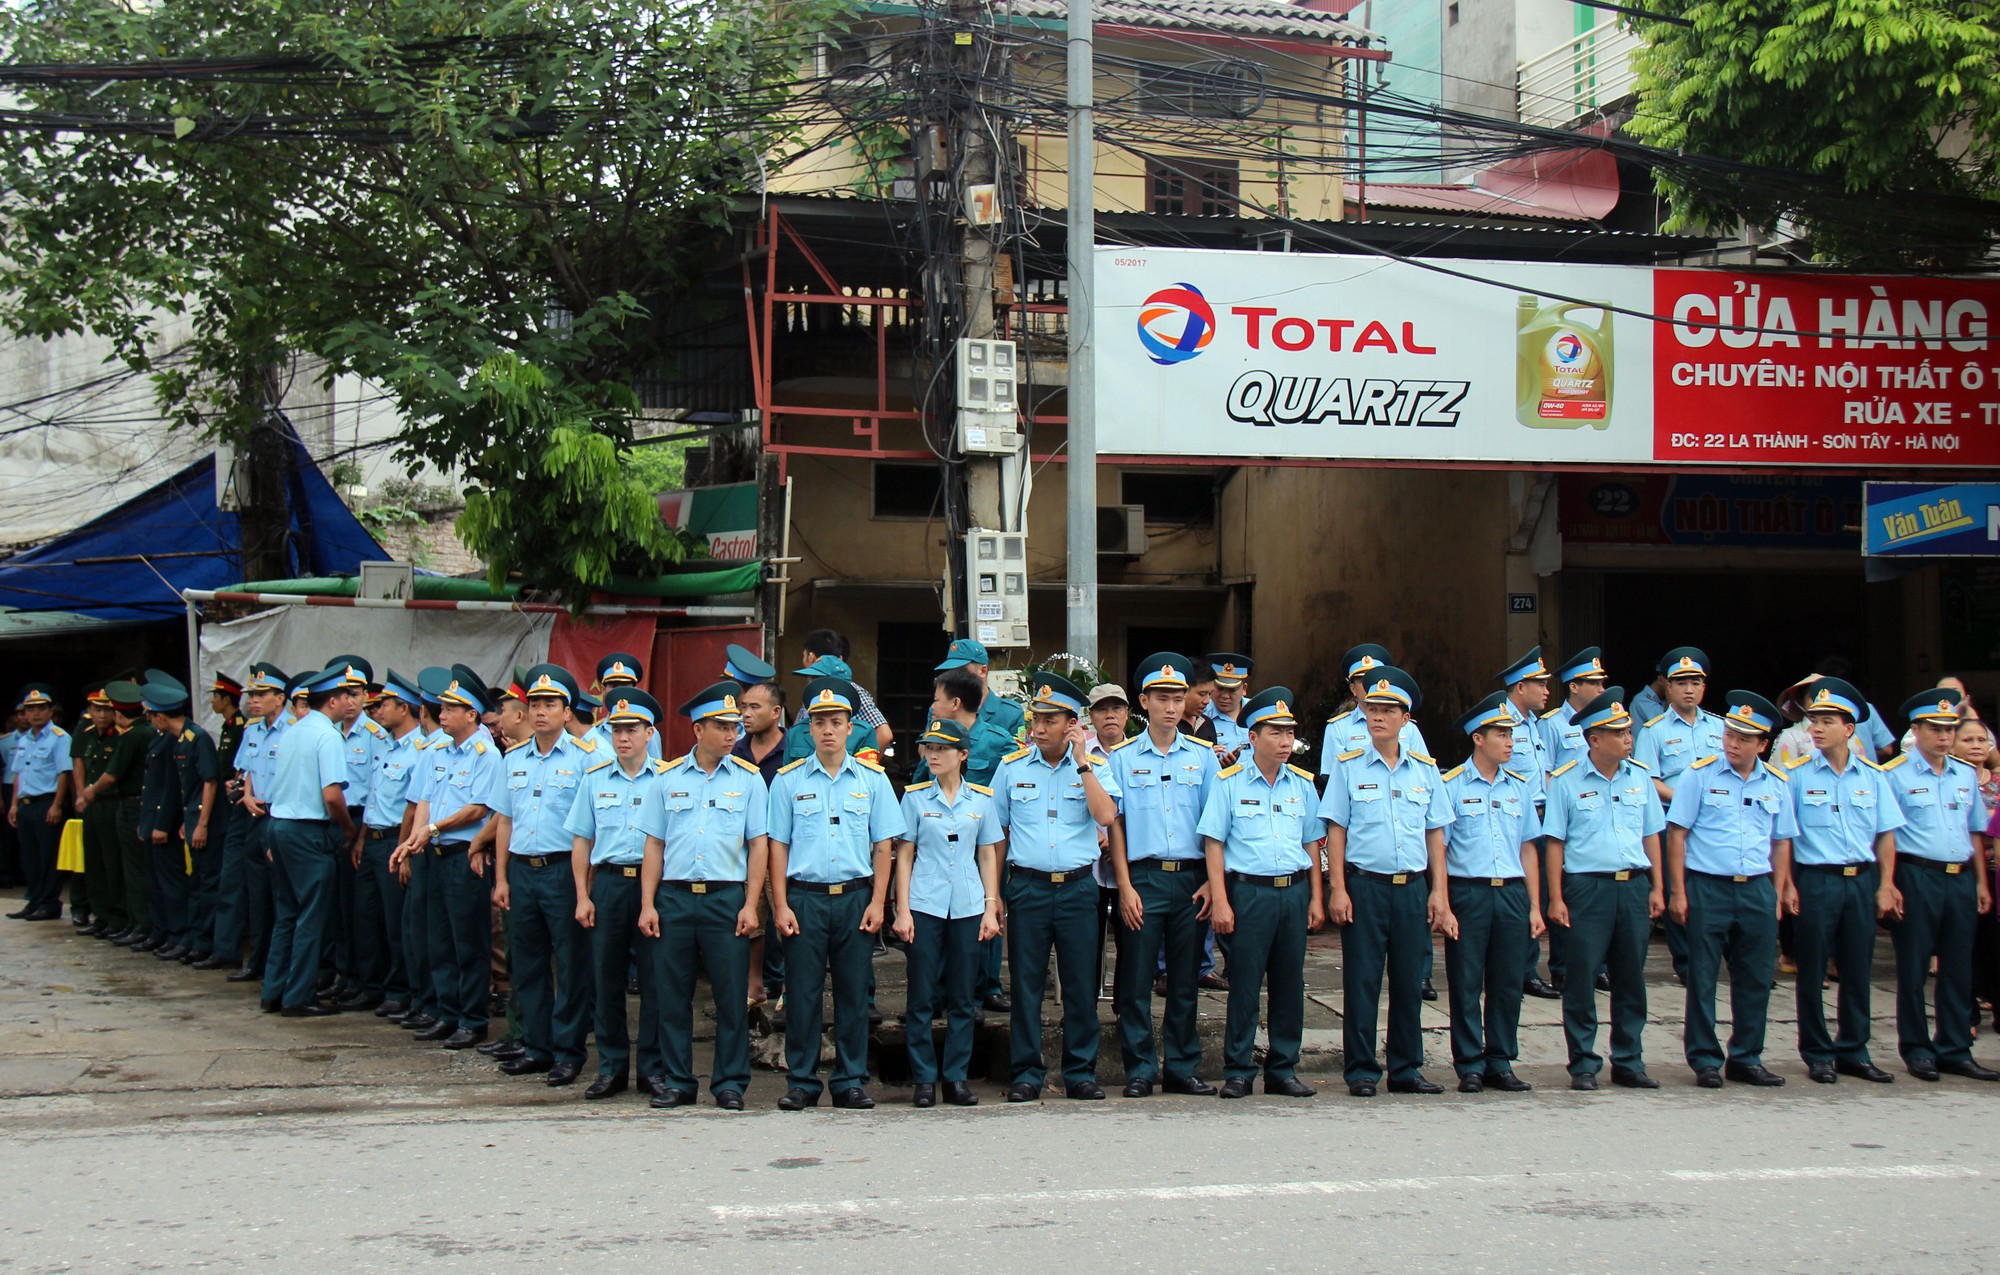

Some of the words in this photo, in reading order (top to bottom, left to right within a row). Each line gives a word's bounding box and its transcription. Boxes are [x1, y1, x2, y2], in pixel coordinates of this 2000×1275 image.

[1114, 258, 1147, 267] 05/2017
[1672, 280, 1801, 348] CỬA
[1818, 285, 1988, 352] HÀNG
[1552, 378, 1595, 388] QUARTZ
[1671, 358, 1805, 387] CHUYÊN:
[1814, 361, 1868, 394] NỘI
[1875, 358, 1953, 389] THẤT
[1960, 361, 1984, 390] Ô
[1226, 369, 1471, 427] QUARTZ
[1843, 395, 1906, 425] RỬA
[1912, 402, 1953, 425] XE
[1671, 433, 1699, 448] ĐC:
[1703, 434, 1725, 448] 22
[1729, 434, 1750, 448] LA
[1753, 431, 1808, 449] THÀNH
[1822, 432, 1857, 449] SƠN
[1860, 432, 1891, 449] TÂY
[1905, 433, 1928, 449] HÀ
[1932, 433, 1960, 454] NỘI
[1596, 489, 1630, 512] 22
[1674, 492, 1729, 541] NỘI
[1734, 490, 1808, 535] THẤT
[1813, 494, 1838, 536] Ô
[1882, 512, 1920, 541] Văn
[1918, 498, 1963, 529] Tuân
[709, 534, 756, 559] Castrol
[1513, 598, 1532, 609] 274
